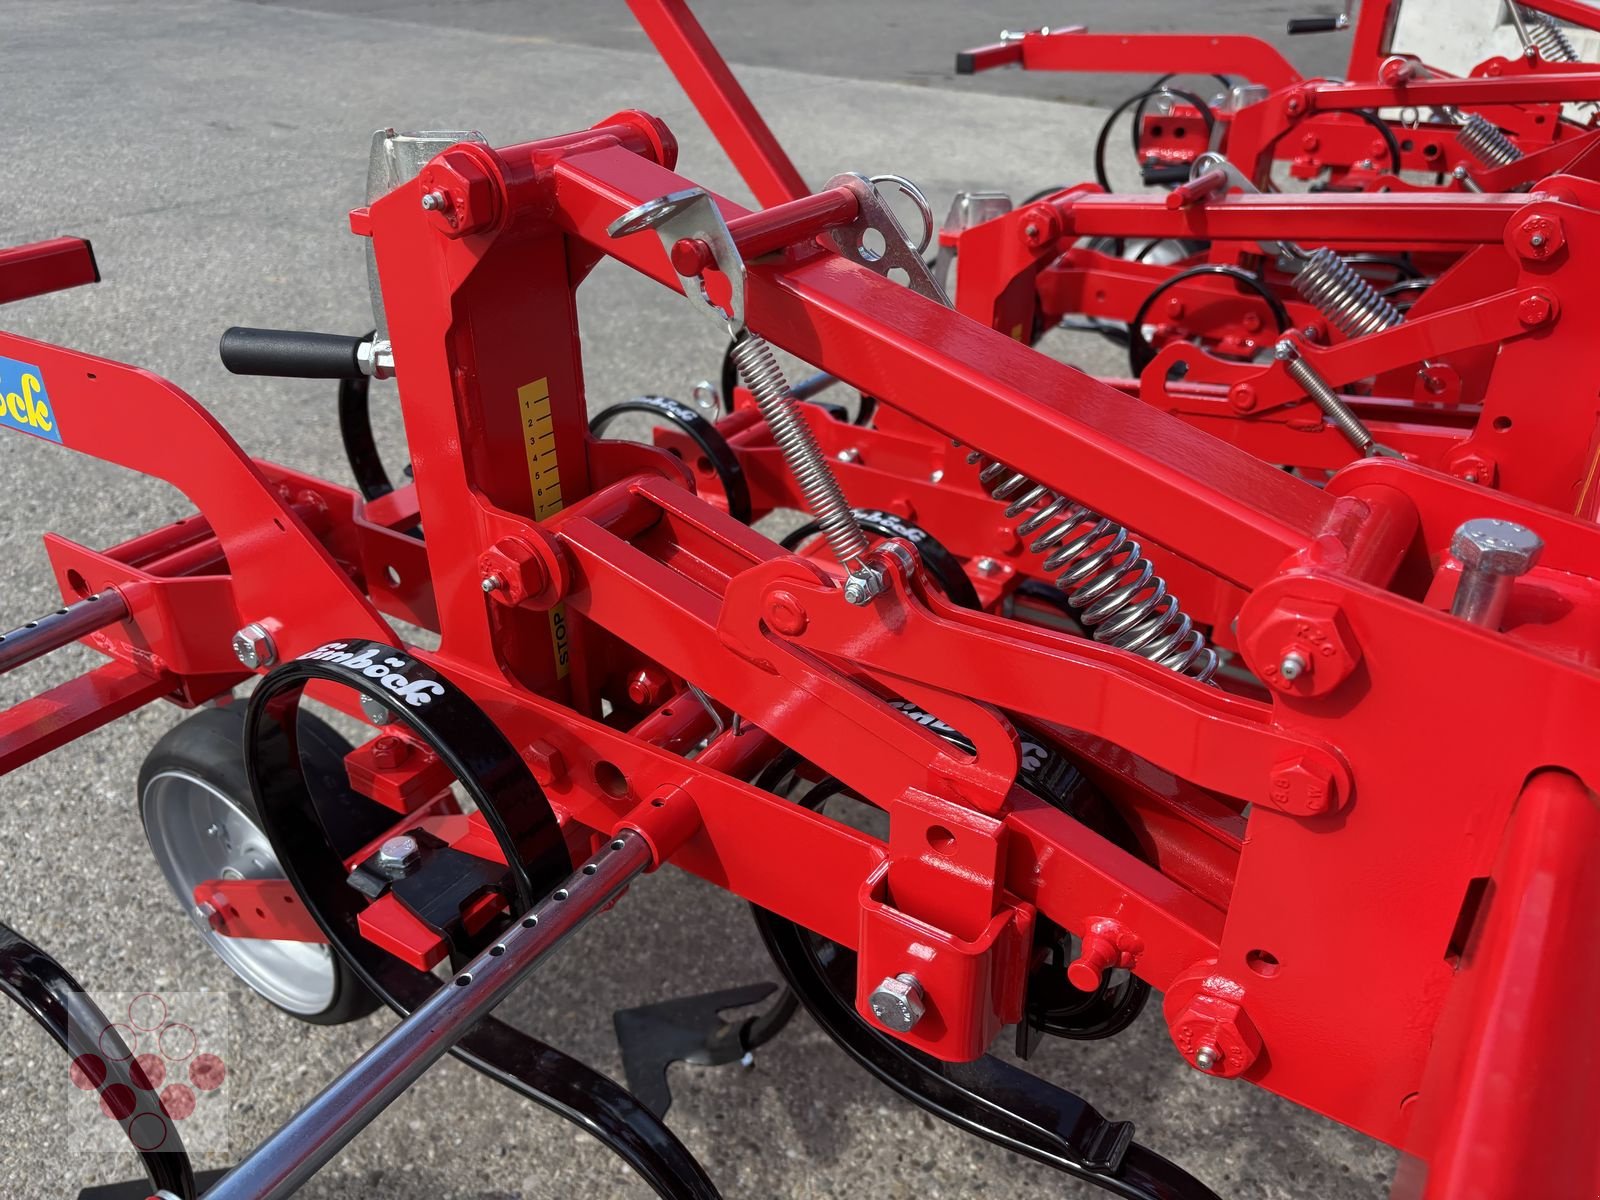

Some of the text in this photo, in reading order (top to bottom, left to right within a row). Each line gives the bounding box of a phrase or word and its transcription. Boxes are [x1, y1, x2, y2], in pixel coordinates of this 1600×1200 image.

[525, 401, 530, 409] 1
[528, 418, 533, 428] 2
[530, 437, 535, 446] 3
[533, 454, 538, 463] 4
[535, 471, 540, 480] 5
[537, 489, 543, 497] 6
[540, 505, 545, 513] 7
[554, 613, 569, 666] STOP
[296, 642, 446, 708] Einböck
